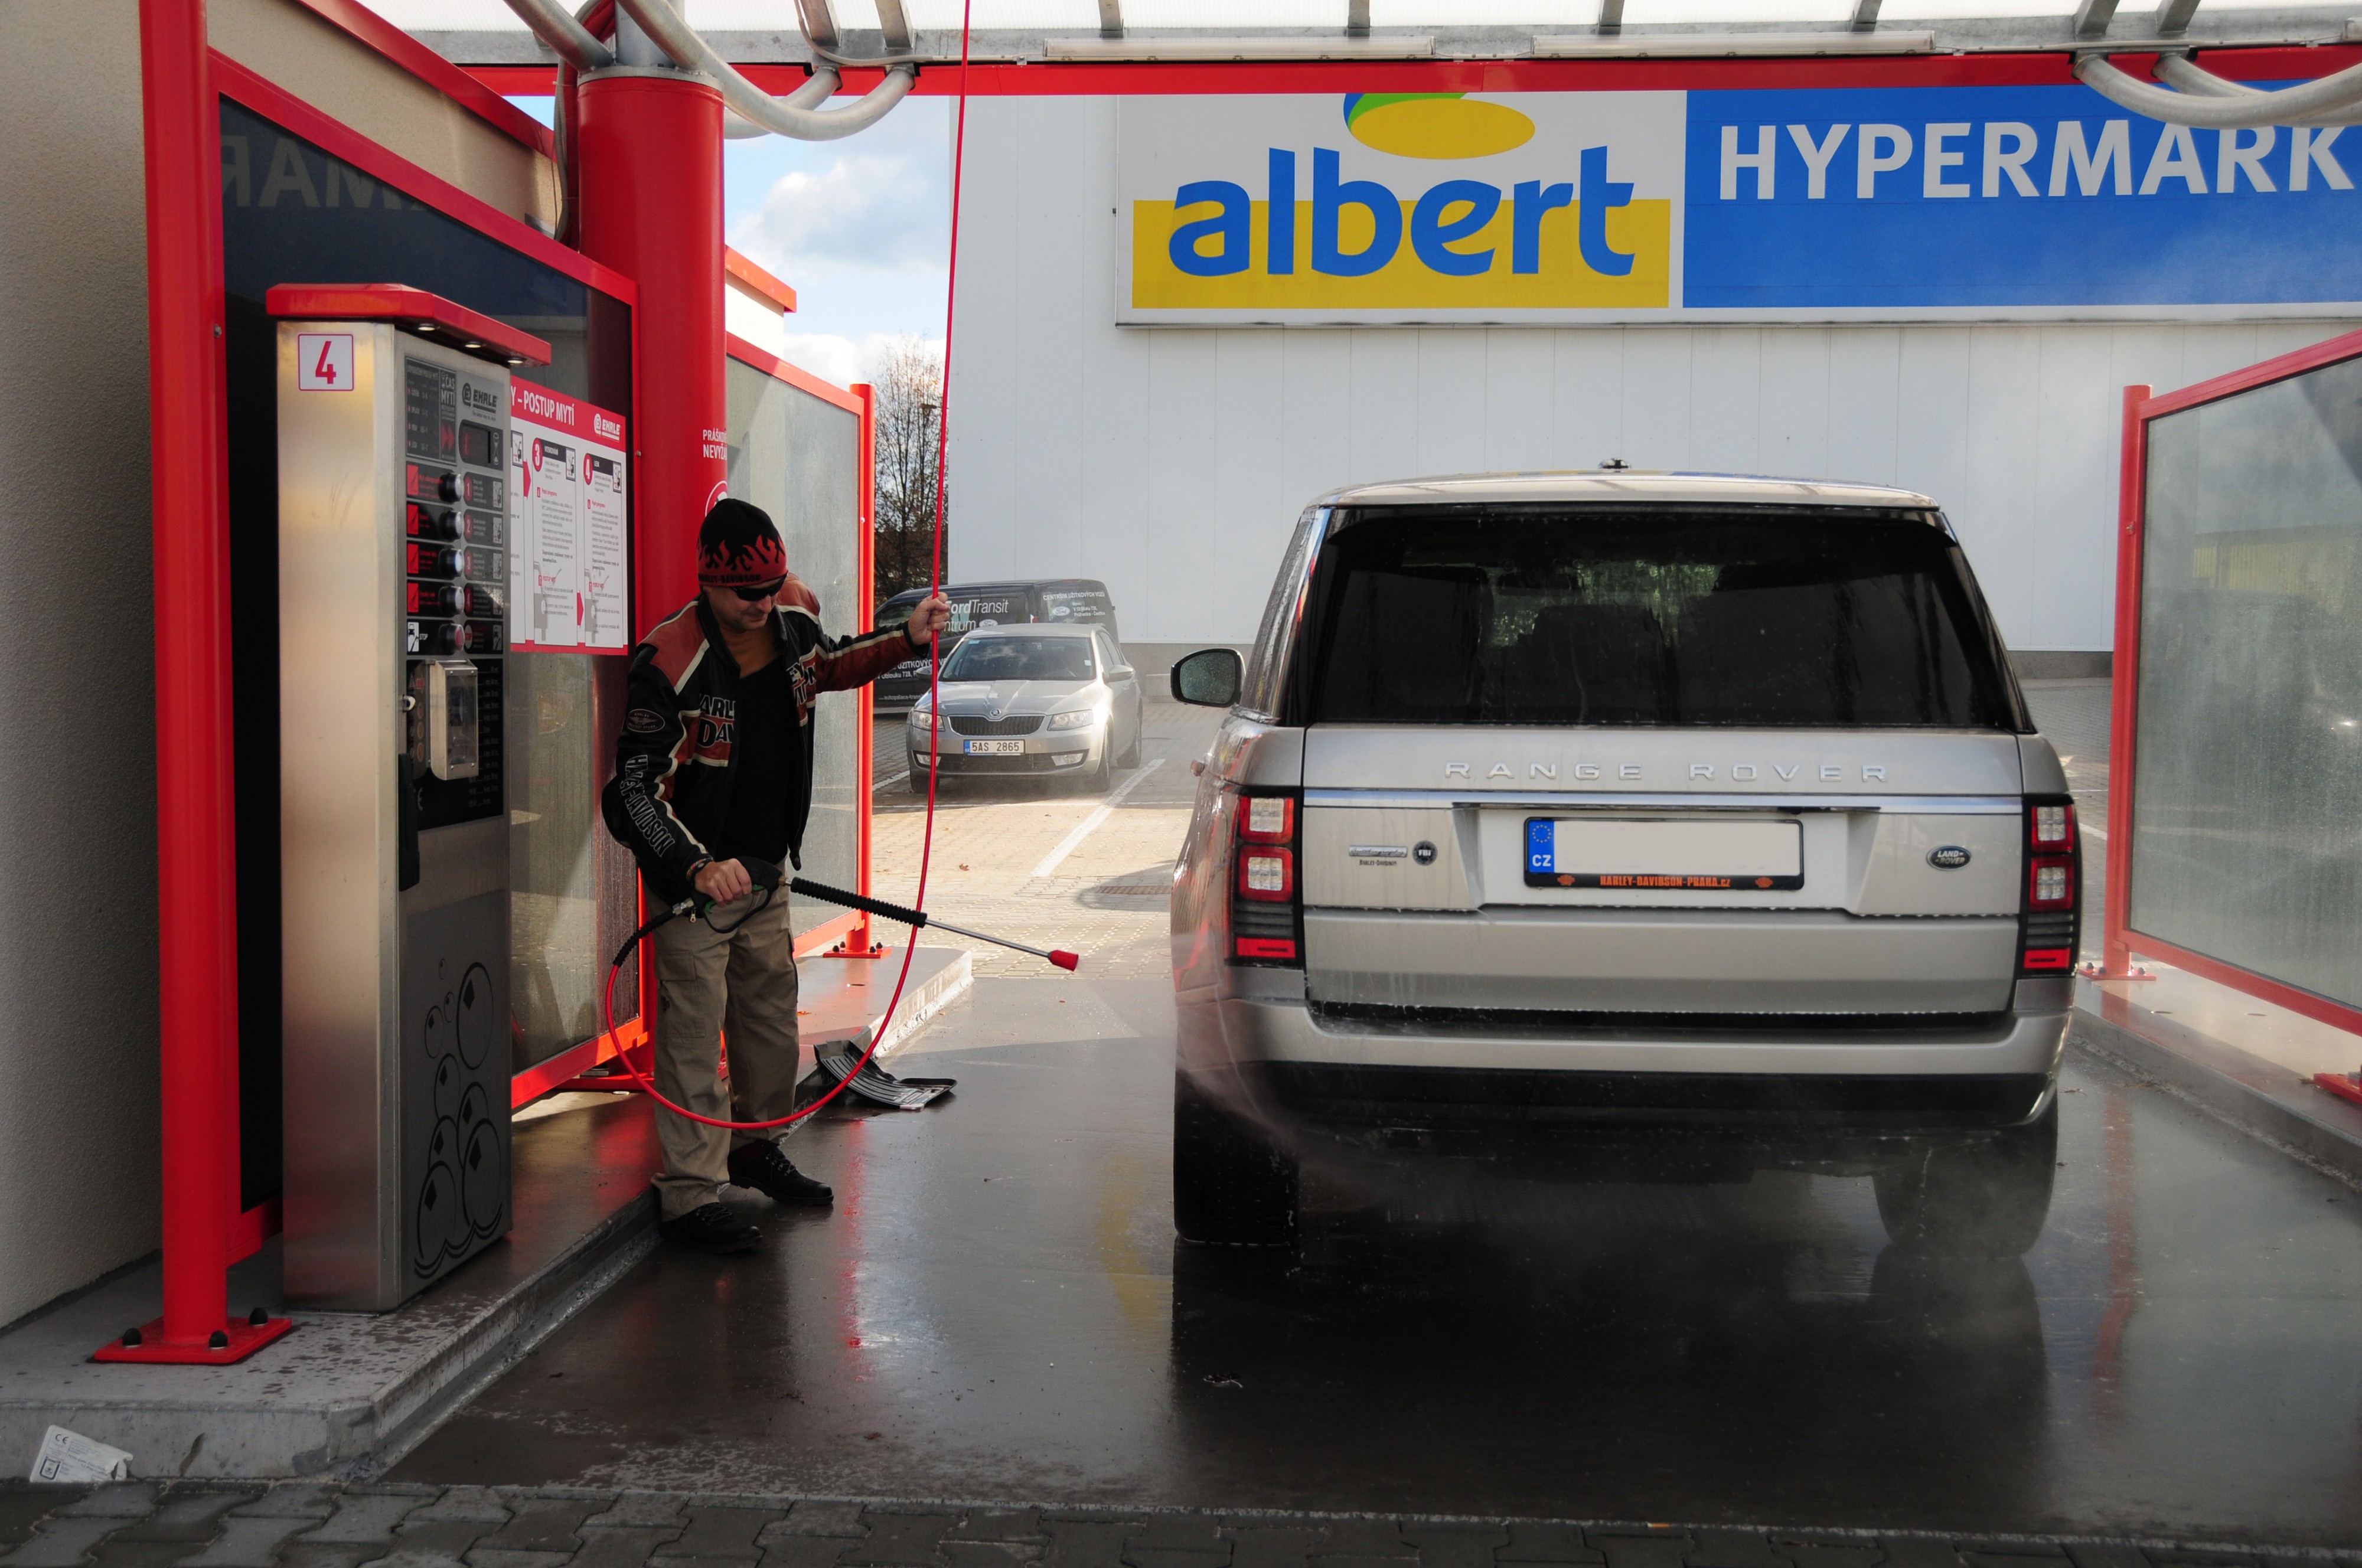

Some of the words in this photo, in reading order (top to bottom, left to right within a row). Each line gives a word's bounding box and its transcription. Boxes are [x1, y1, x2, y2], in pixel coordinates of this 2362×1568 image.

[1720, 120, 2354, 200] HYPERMARK
[1169, 146, 1636, 277] albert
[315, 341, 337, 384] 4
[473, 389, 497, 407] EHRLE
[524, 390, 555, 419] POSTUP
[556, 402, 575, 426] MYTÍ
[602, 419, 621, 435] EHRLE
[535, 444, 540, 466] 3
[586, 459, 590, 479] 4
[467, 483, 470, 496] 1
[467, 519, 470, 533] 2
[972, 742, 989, 752] 5AS
[996, 742, 1019, 752] 2865
[1444, 760, 1643, 781] RANGE
[1689, 762, 1888, 783] ROVER
[1532, 854, 1551, 867] CZ
